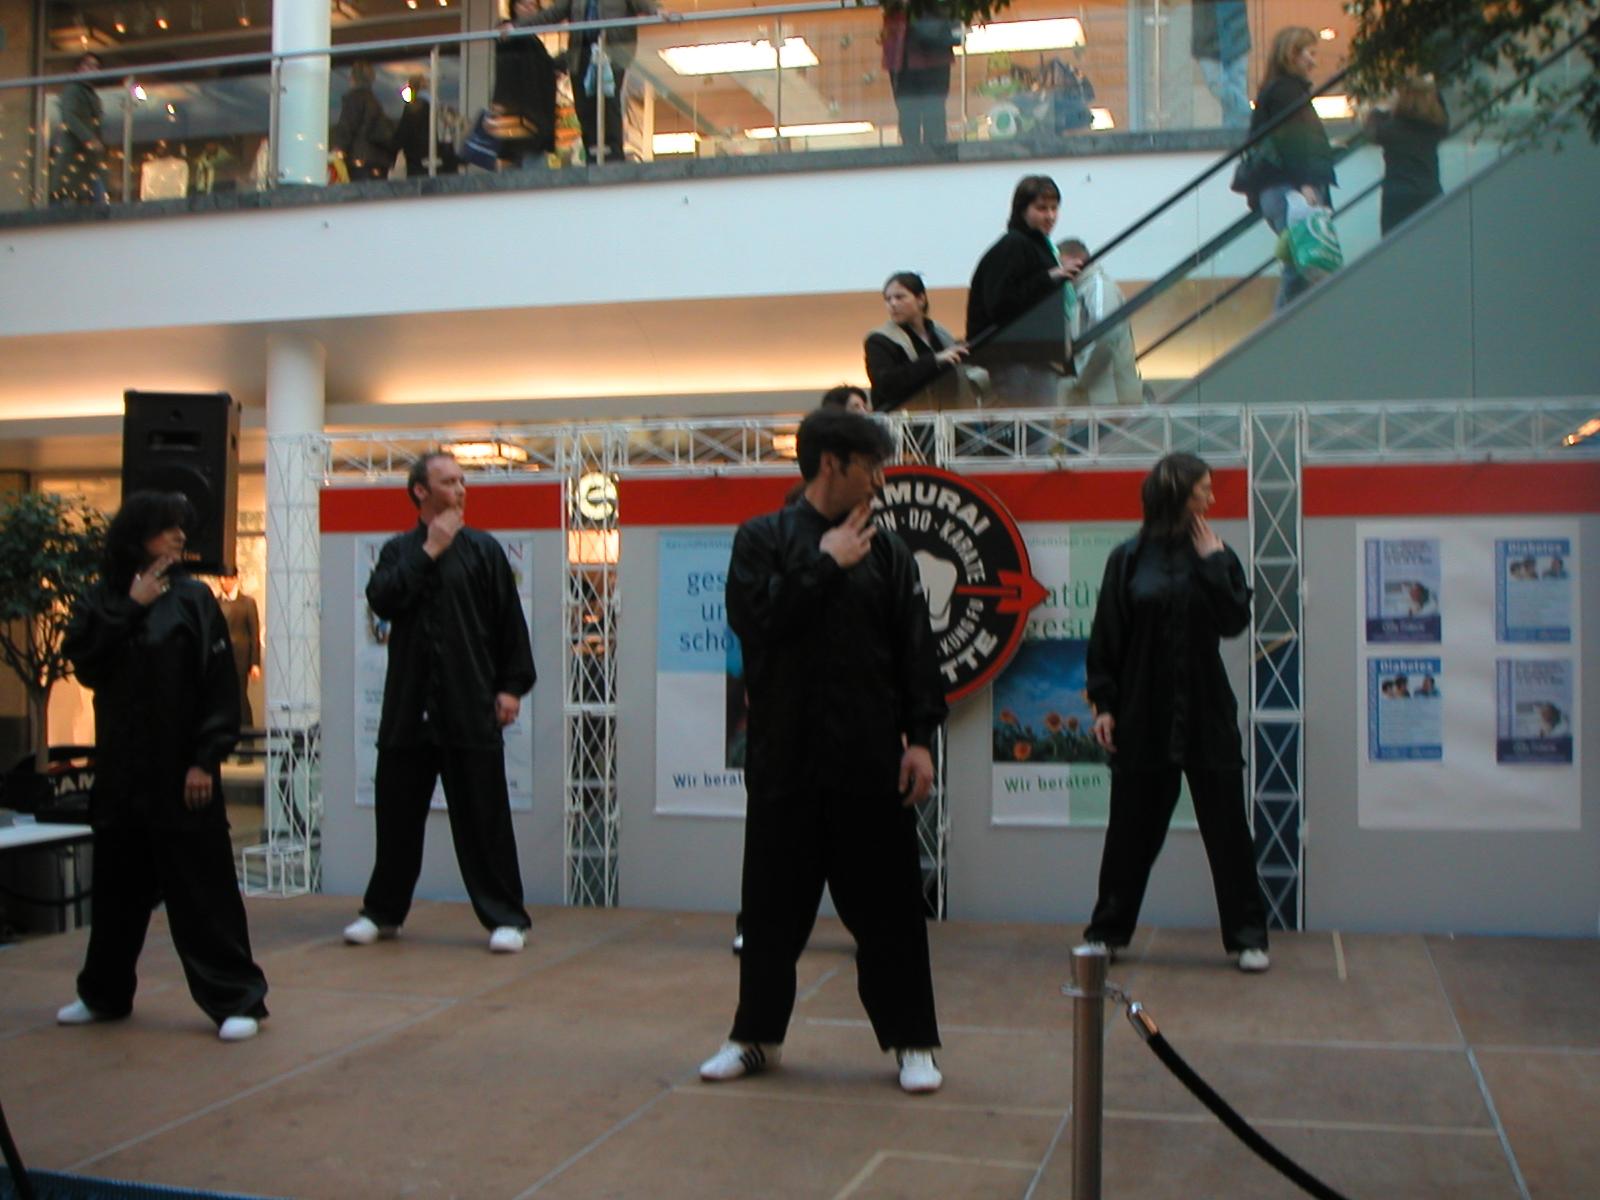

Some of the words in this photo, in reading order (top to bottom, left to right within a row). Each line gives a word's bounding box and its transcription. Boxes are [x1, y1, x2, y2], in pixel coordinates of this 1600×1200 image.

[870, 481, 990, 536] AMURAI
[687, 571, 726, 597] ges
[939, 628, 998, 684] TTE
[672, 772, 697, 788] Wir
[703, 769, 744, 786] berat
[1004, 775, 1031, 793] Wir
[1038, 773, 1101, 791] beraten
